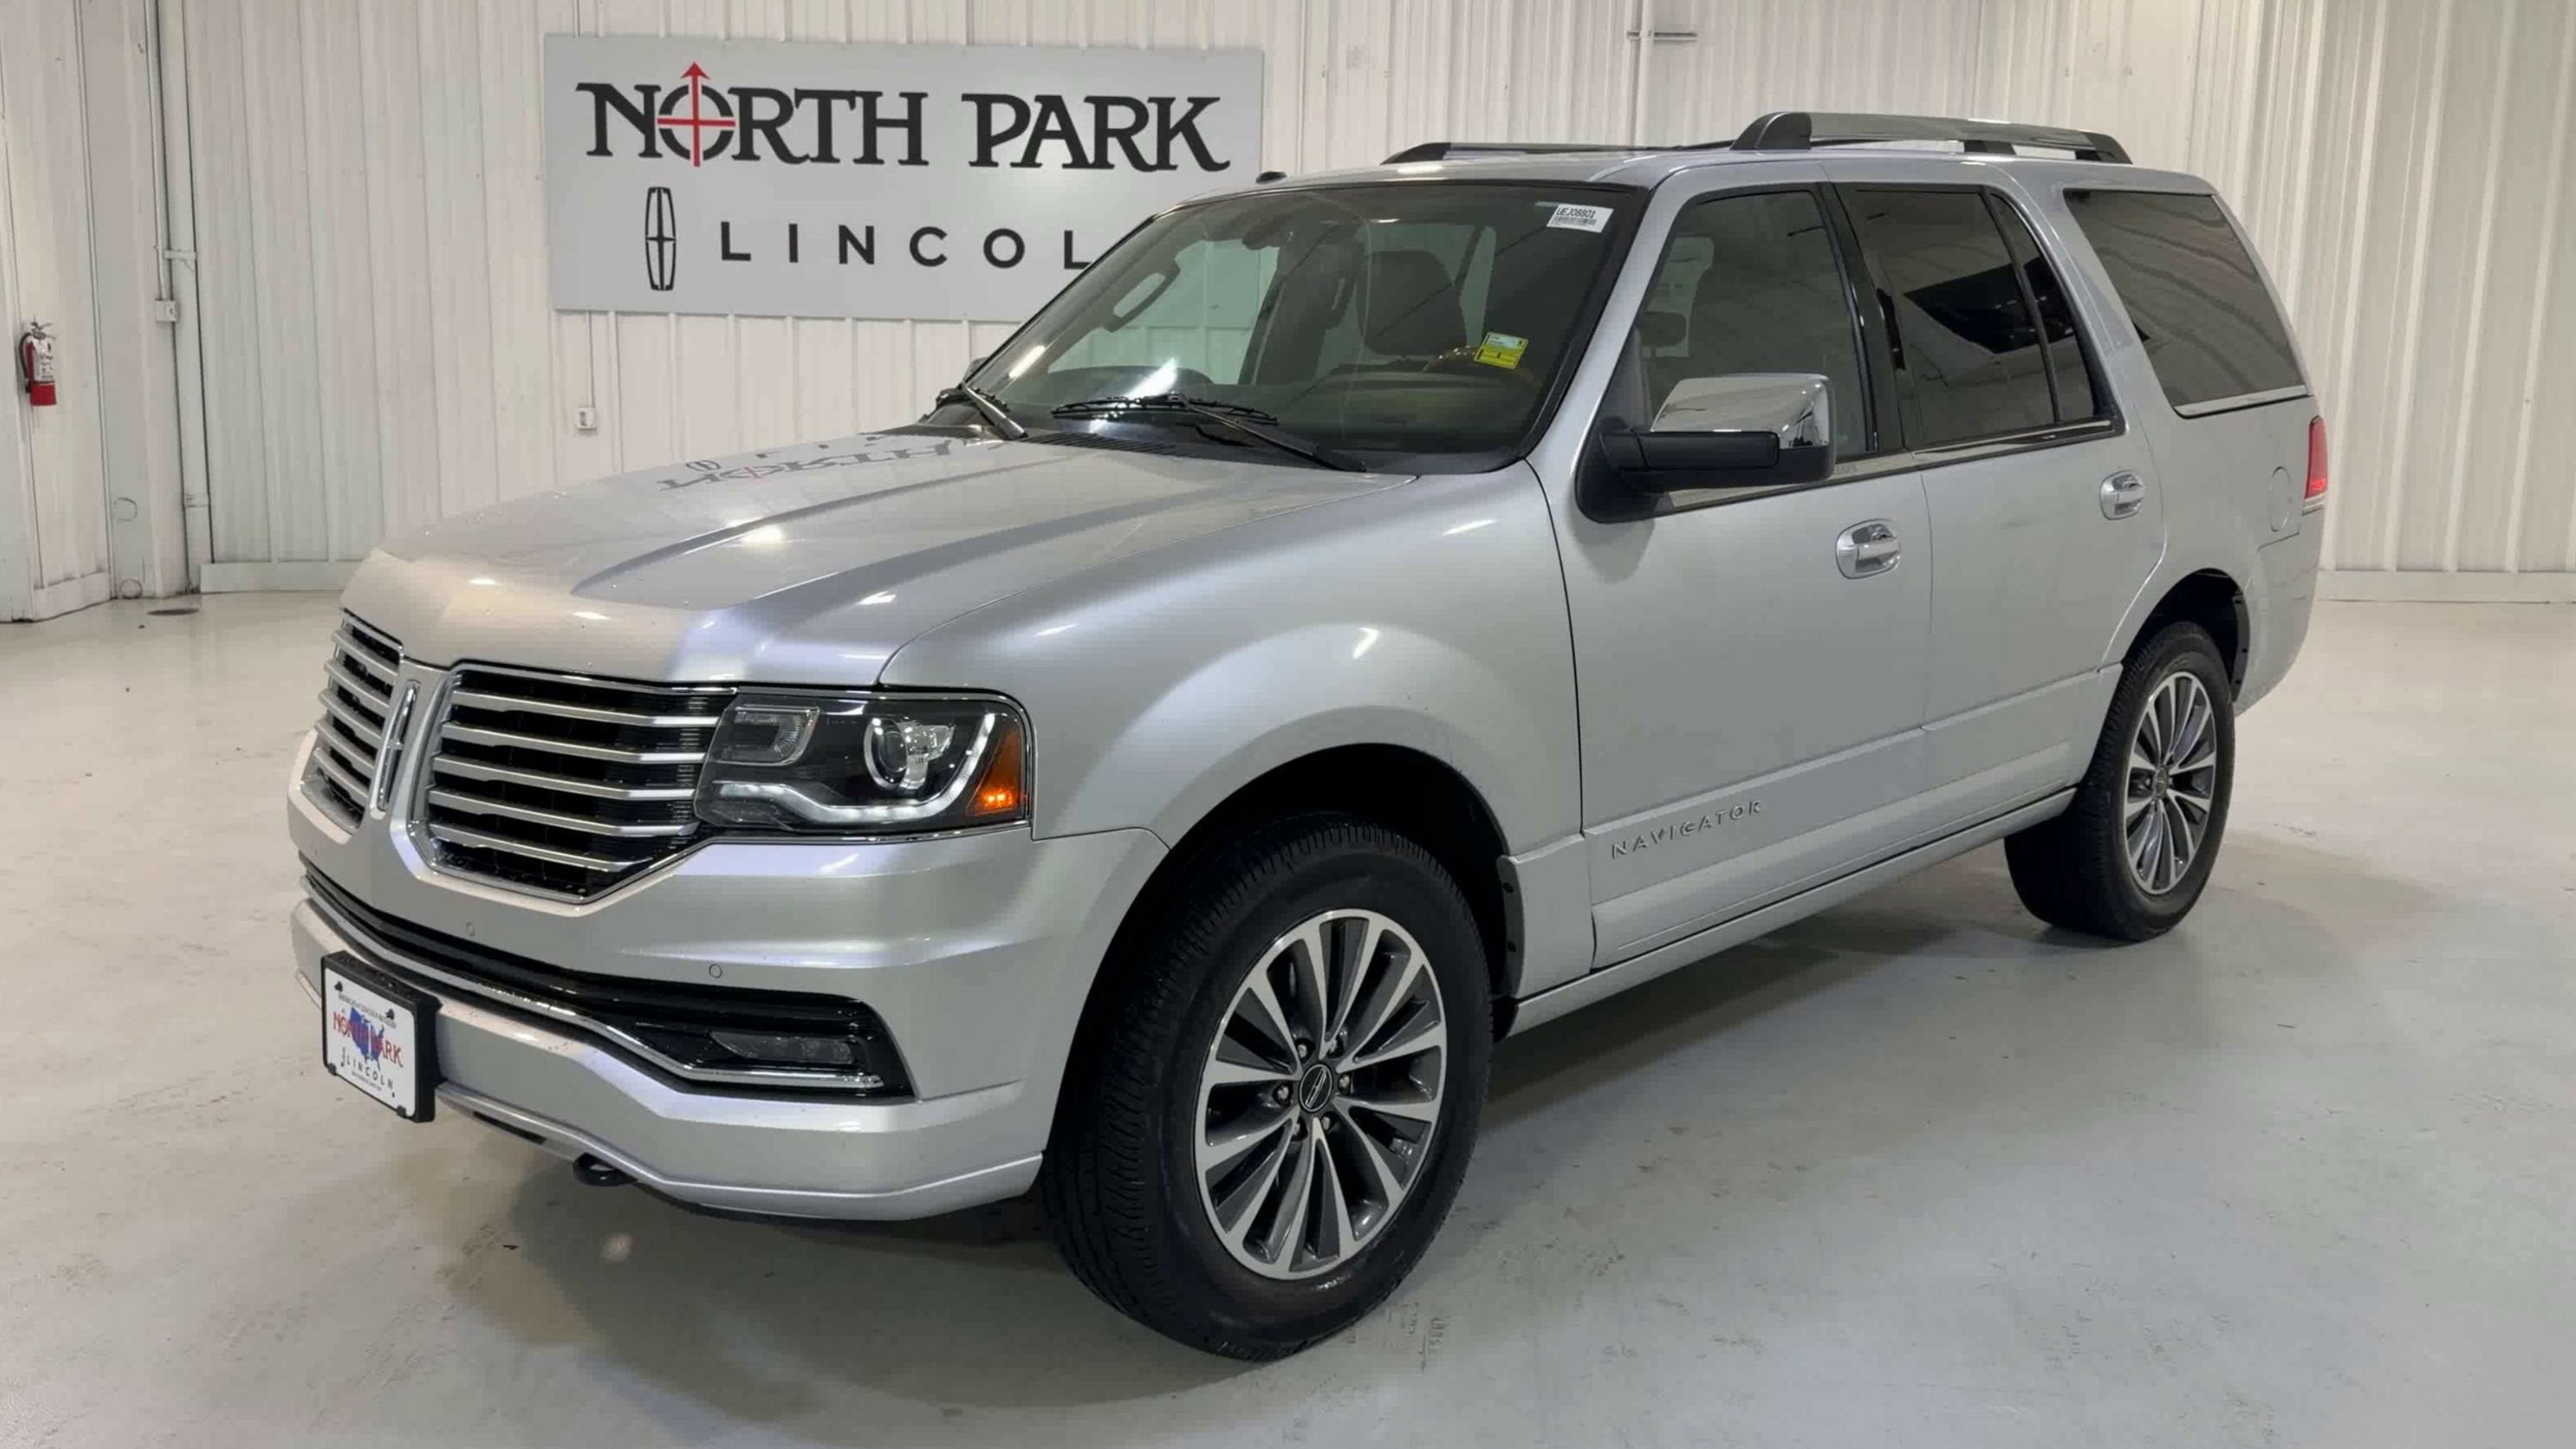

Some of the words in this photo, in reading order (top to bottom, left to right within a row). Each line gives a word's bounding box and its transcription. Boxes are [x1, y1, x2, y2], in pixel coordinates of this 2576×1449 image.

[575, 81, 930, 167] NORTH
[960, 93, 1231, 173] PARK
[720, 221, 1091, 270] LINCOL
[1611, 800, 1762, 859] NAVIGATOR
[333, 1010, 368, 1046] NORTH
[371, 1033, 404, 1068] PARK
[346, 1054, 393, 1090] LINCOLN
